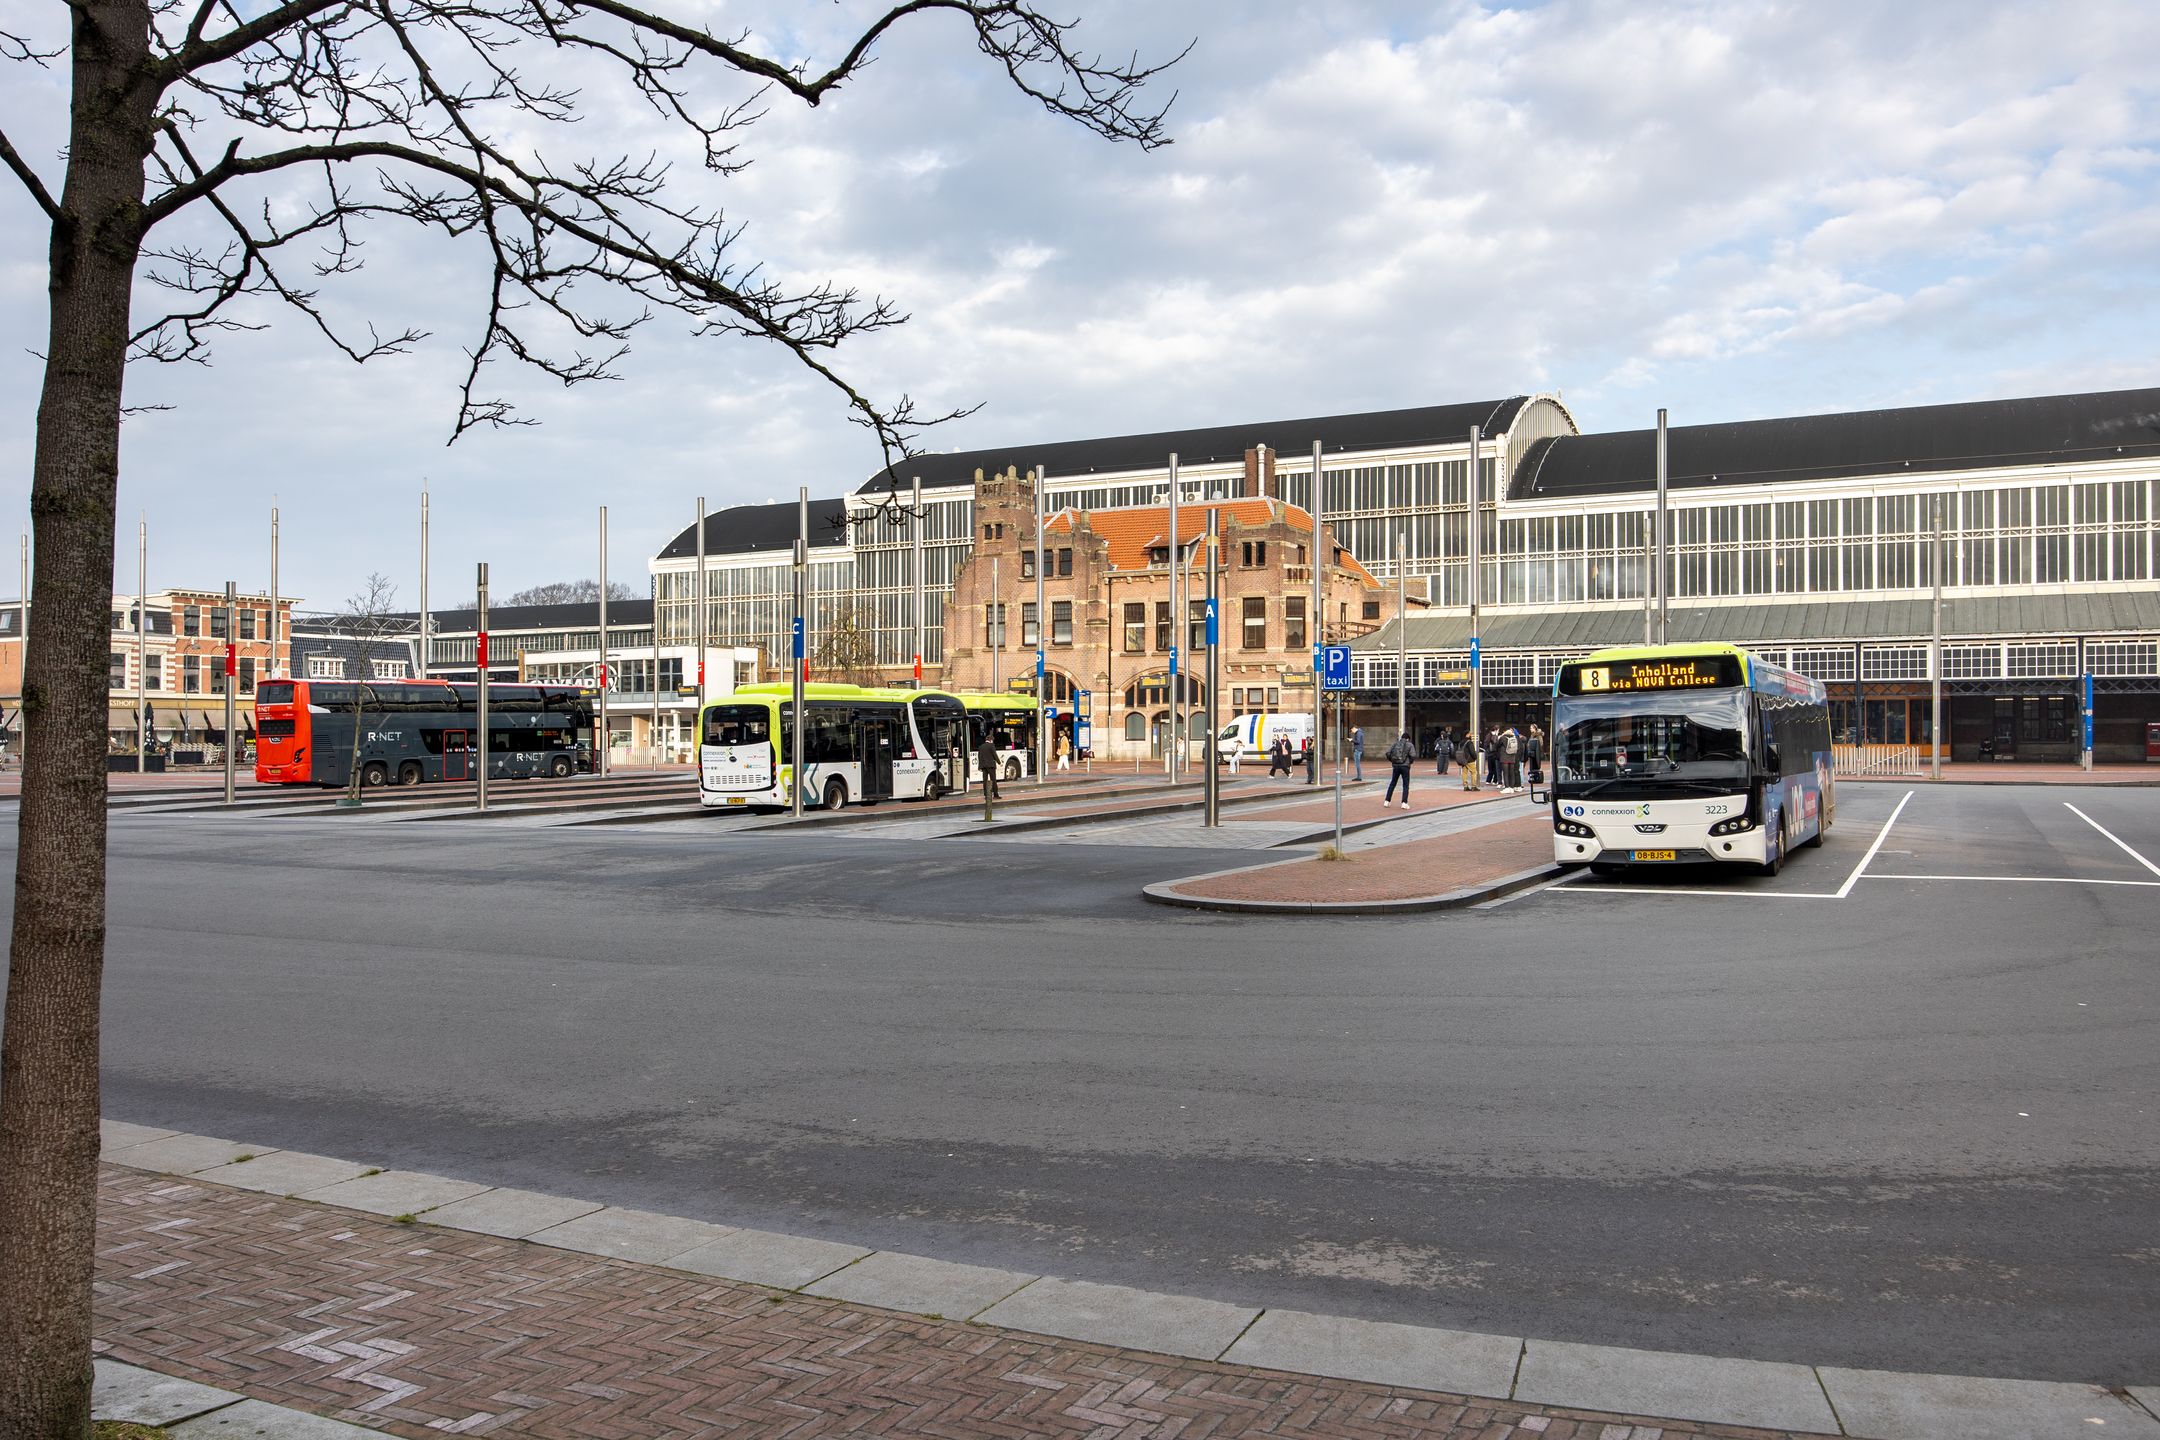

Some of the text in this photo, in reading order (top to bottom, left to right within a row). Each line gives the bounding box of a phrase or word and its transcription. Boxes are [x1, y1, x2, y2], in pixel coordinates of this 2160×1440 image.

[1205, 604, 1215, 618] A
[792, 622, 800, 635] C
[1313, 646, 1320, 656] B
[1470, 641, 1478, 651] A
[1169, 650, 1175, 659] C
[1329, 649, 1344, 671] P
[1631, 662, 1695, 678] Inholland
[1326, 675, 1348, 685] taxi
[1591, 670, 1600, 688] 8
[1611, 675, 1716, 689] via NOVA College
[1591, 806, 1636, 816] connexxion
[1705, 804, 1728, 815] 3223
[1637, 851, 1673, 860] 08-BJS-4
